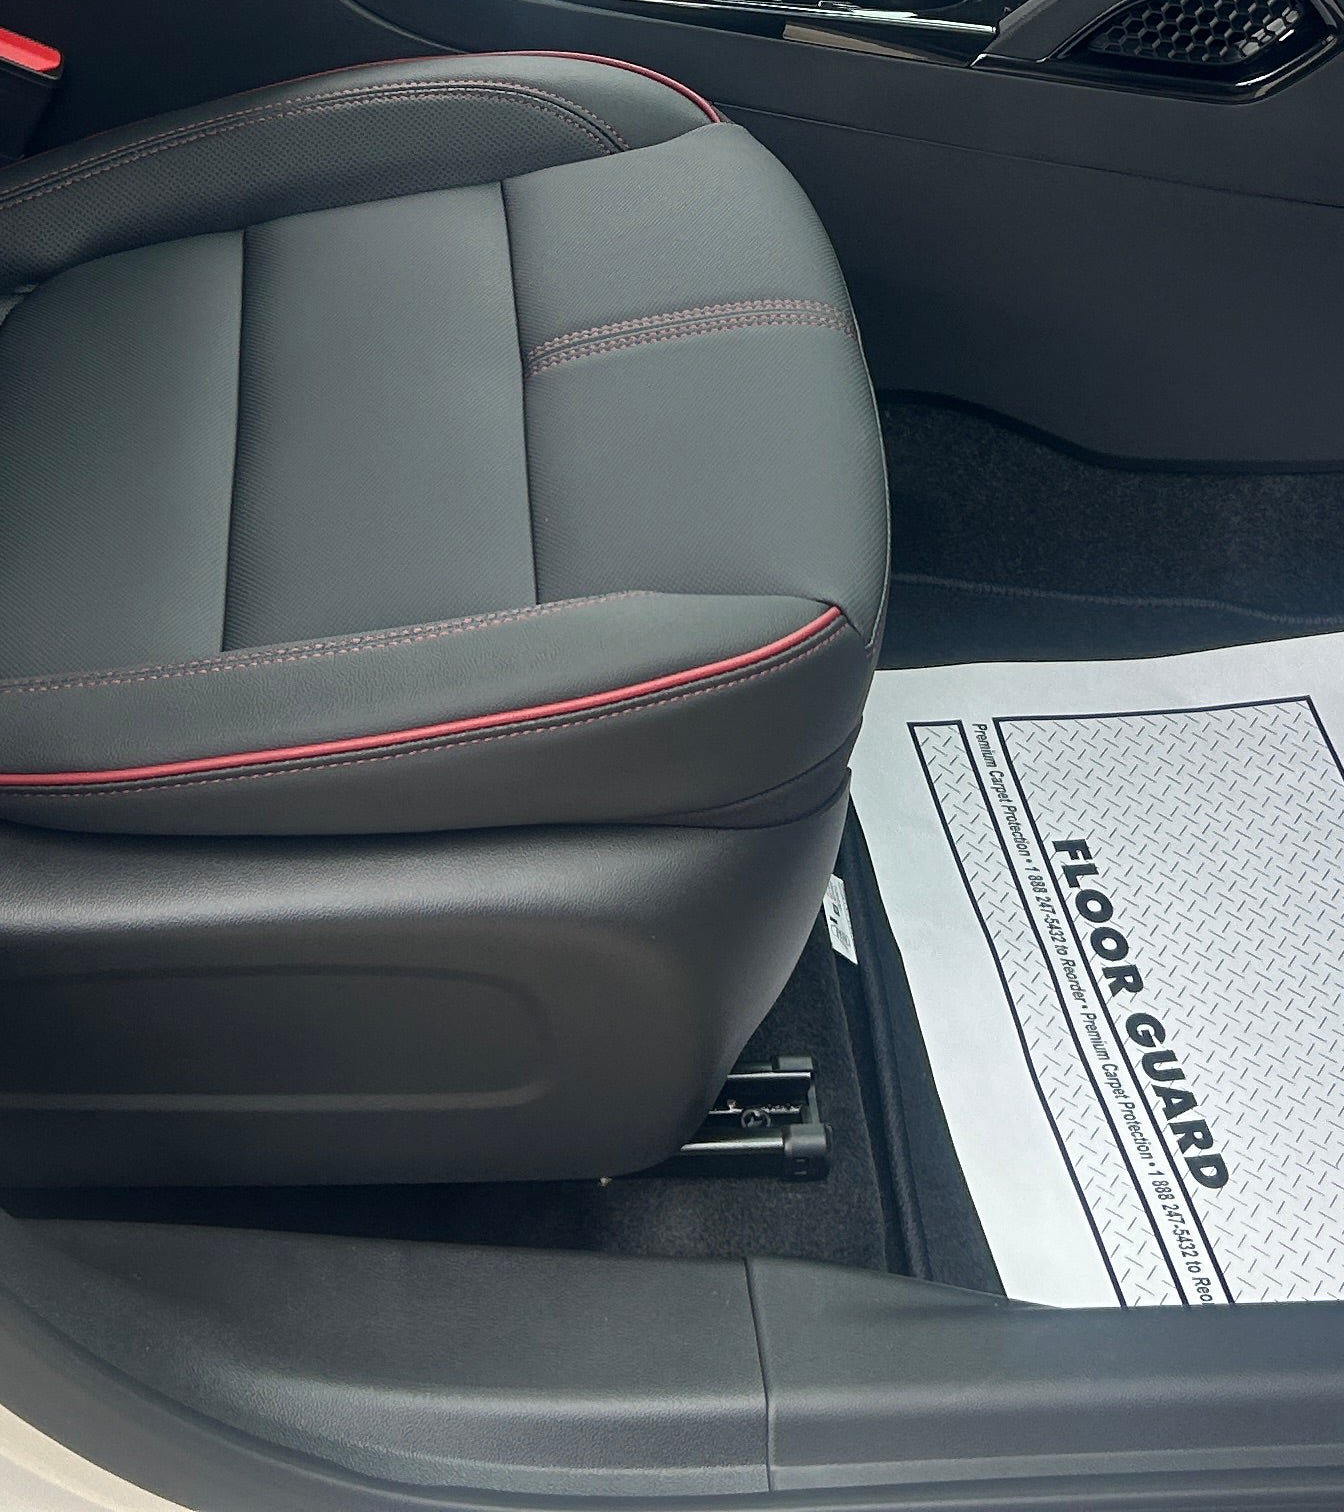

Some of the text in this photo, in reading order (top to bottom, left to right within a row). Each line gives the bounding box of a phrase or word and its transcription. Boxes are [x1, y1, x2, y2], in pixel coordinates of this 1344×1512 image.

[972, 723, 997, 768] Premium
[989, 770, 1013, 803] Carpet
[1004, 802, 1031, 857] Protection
[1028, 874, 1047, 893] 888
[1035, 895, 1066, 943] 247-5432
[1055, 944, 1068, 956] to
[1060, 957, 1087, 1004] Reorder
[1052, 838, 1230, 1189] FLOOR GUARD
[1080, 1012, 1110, 1061] Premium
[1102, 1063, 1130, 1099] Carpet
[1118, 1101, 1154, 1160] Protection
[1152, 1180, 1175, 1201] 888
[1162, 1204, 1199, 1258] 247-5432
[1186, 1260, 1202, 1274] to
[1192, 1277, 1215, 1304] Reo
